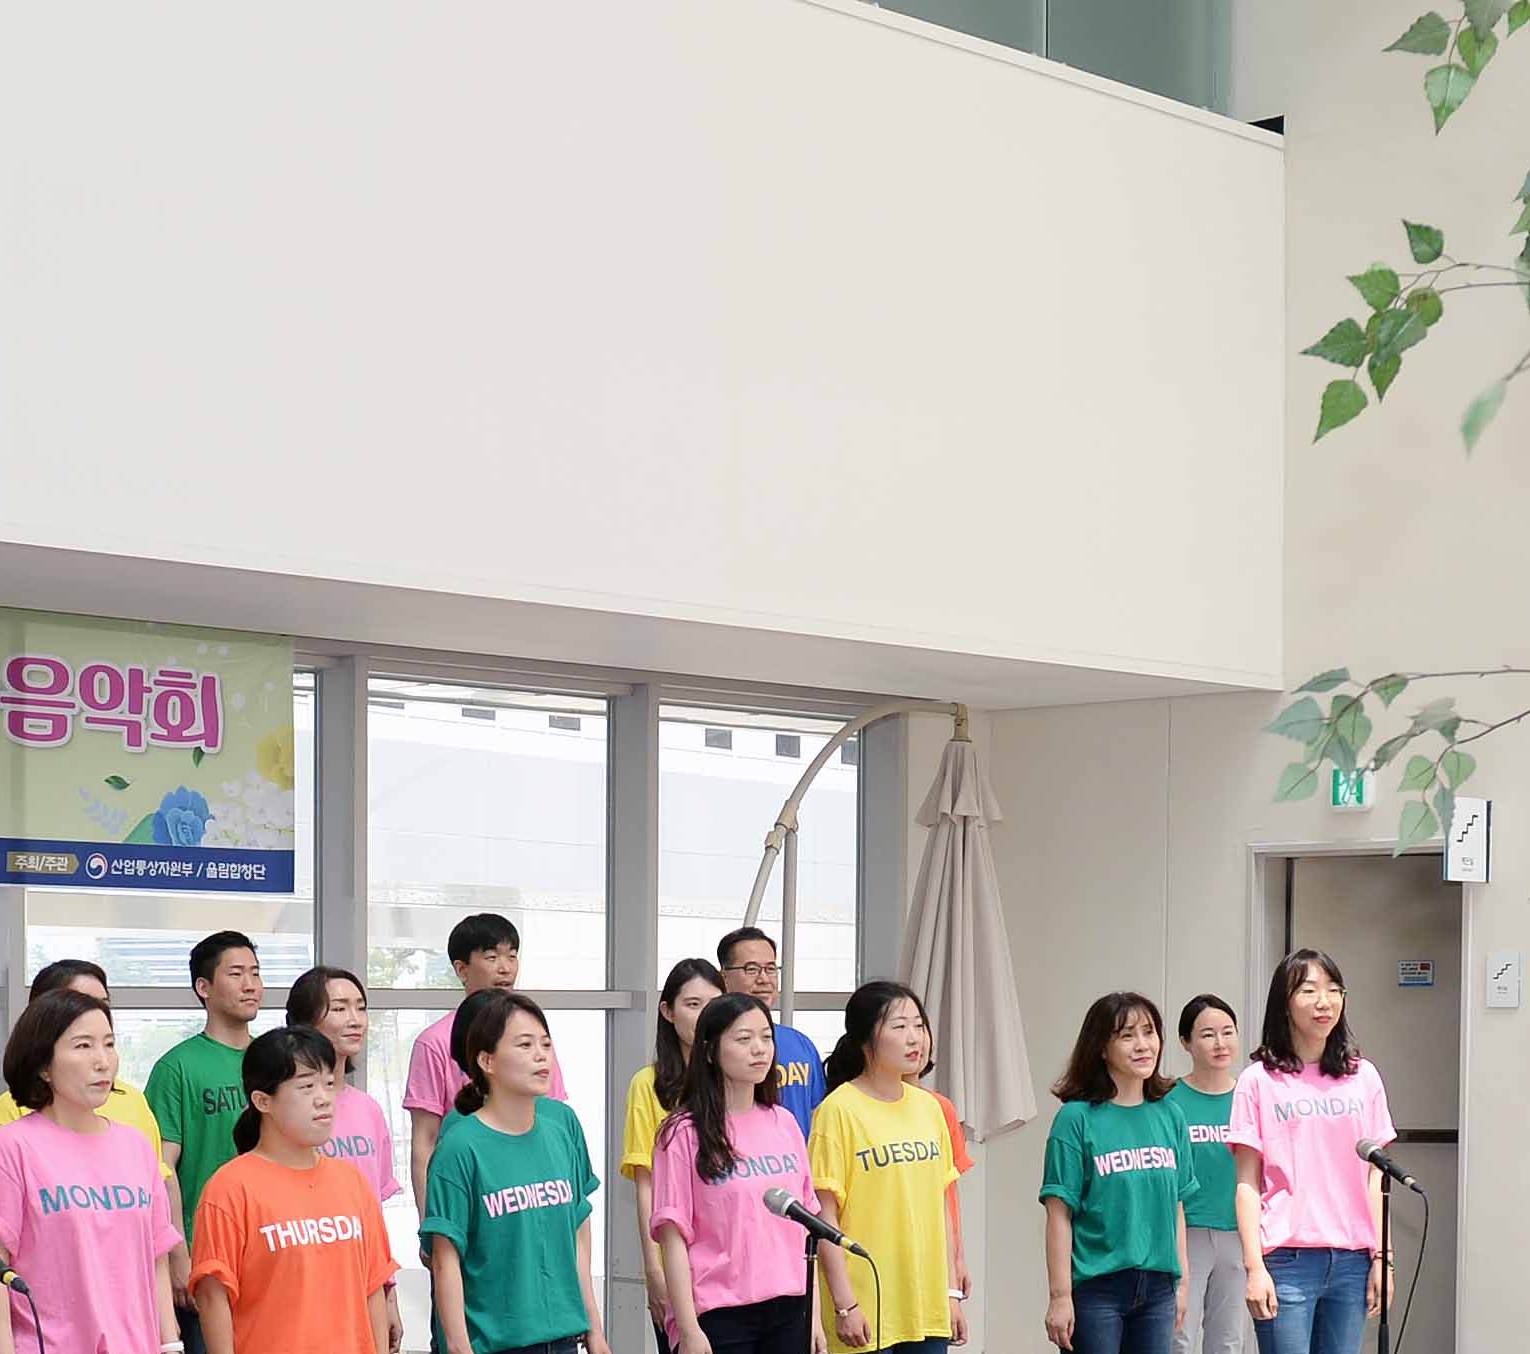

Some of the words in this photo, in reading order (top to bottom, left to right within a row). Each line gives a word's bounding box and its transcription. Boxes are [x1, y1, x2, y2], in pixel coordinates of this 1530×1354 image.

[776, 1062, 811, 1088] DAY
[202, 1085, 250, 1115] SATU
[316, 1135, 376, 1158] OND
[855, 1139, 940, 1172] TUESDA
[1093, 1146, 1177, 1177] WEDNESDA
[38, 1184, 152, 1216] MONDA
[482, 1179, 574, 1218] WEDNESD
[259, 1215, 363, 1252] THURSDA
